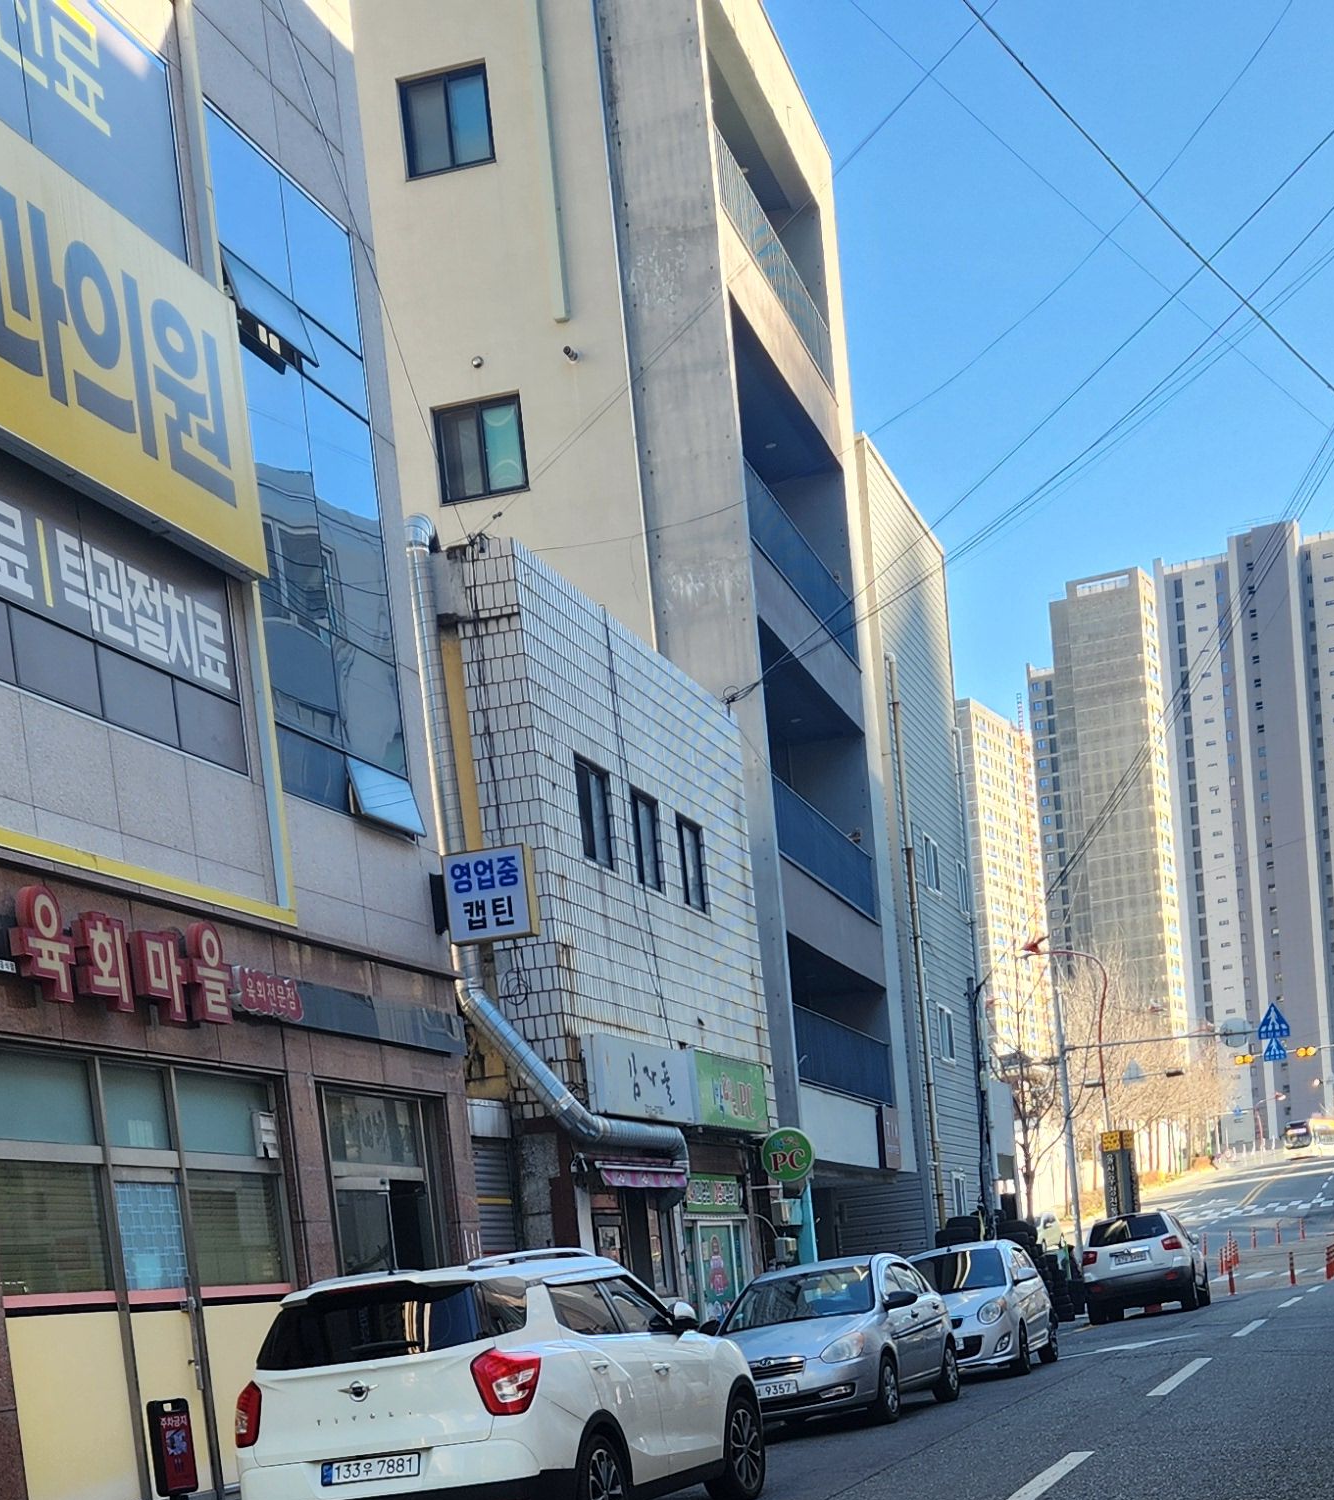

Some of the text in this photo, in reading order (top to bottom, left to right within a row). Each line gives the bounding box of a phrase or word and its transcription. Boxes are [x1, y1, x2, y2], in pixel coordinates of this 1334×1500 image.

[56, 529, 231, 691] 턱관절치료
[450, 856, 518, 893] 영업중
[463, 895, 514, 931] 캡틴
[28, 893, 230, 1017] 육회마을
[246, 976, 297, 1011] 육회전문점
[771, 1149, 806, 1173] PC
[765, 1382, 791, 1396] 9357
[160, 1415, 188, 1429] 주차금지
[334, 1456, 413, 1481] 133우 7881
